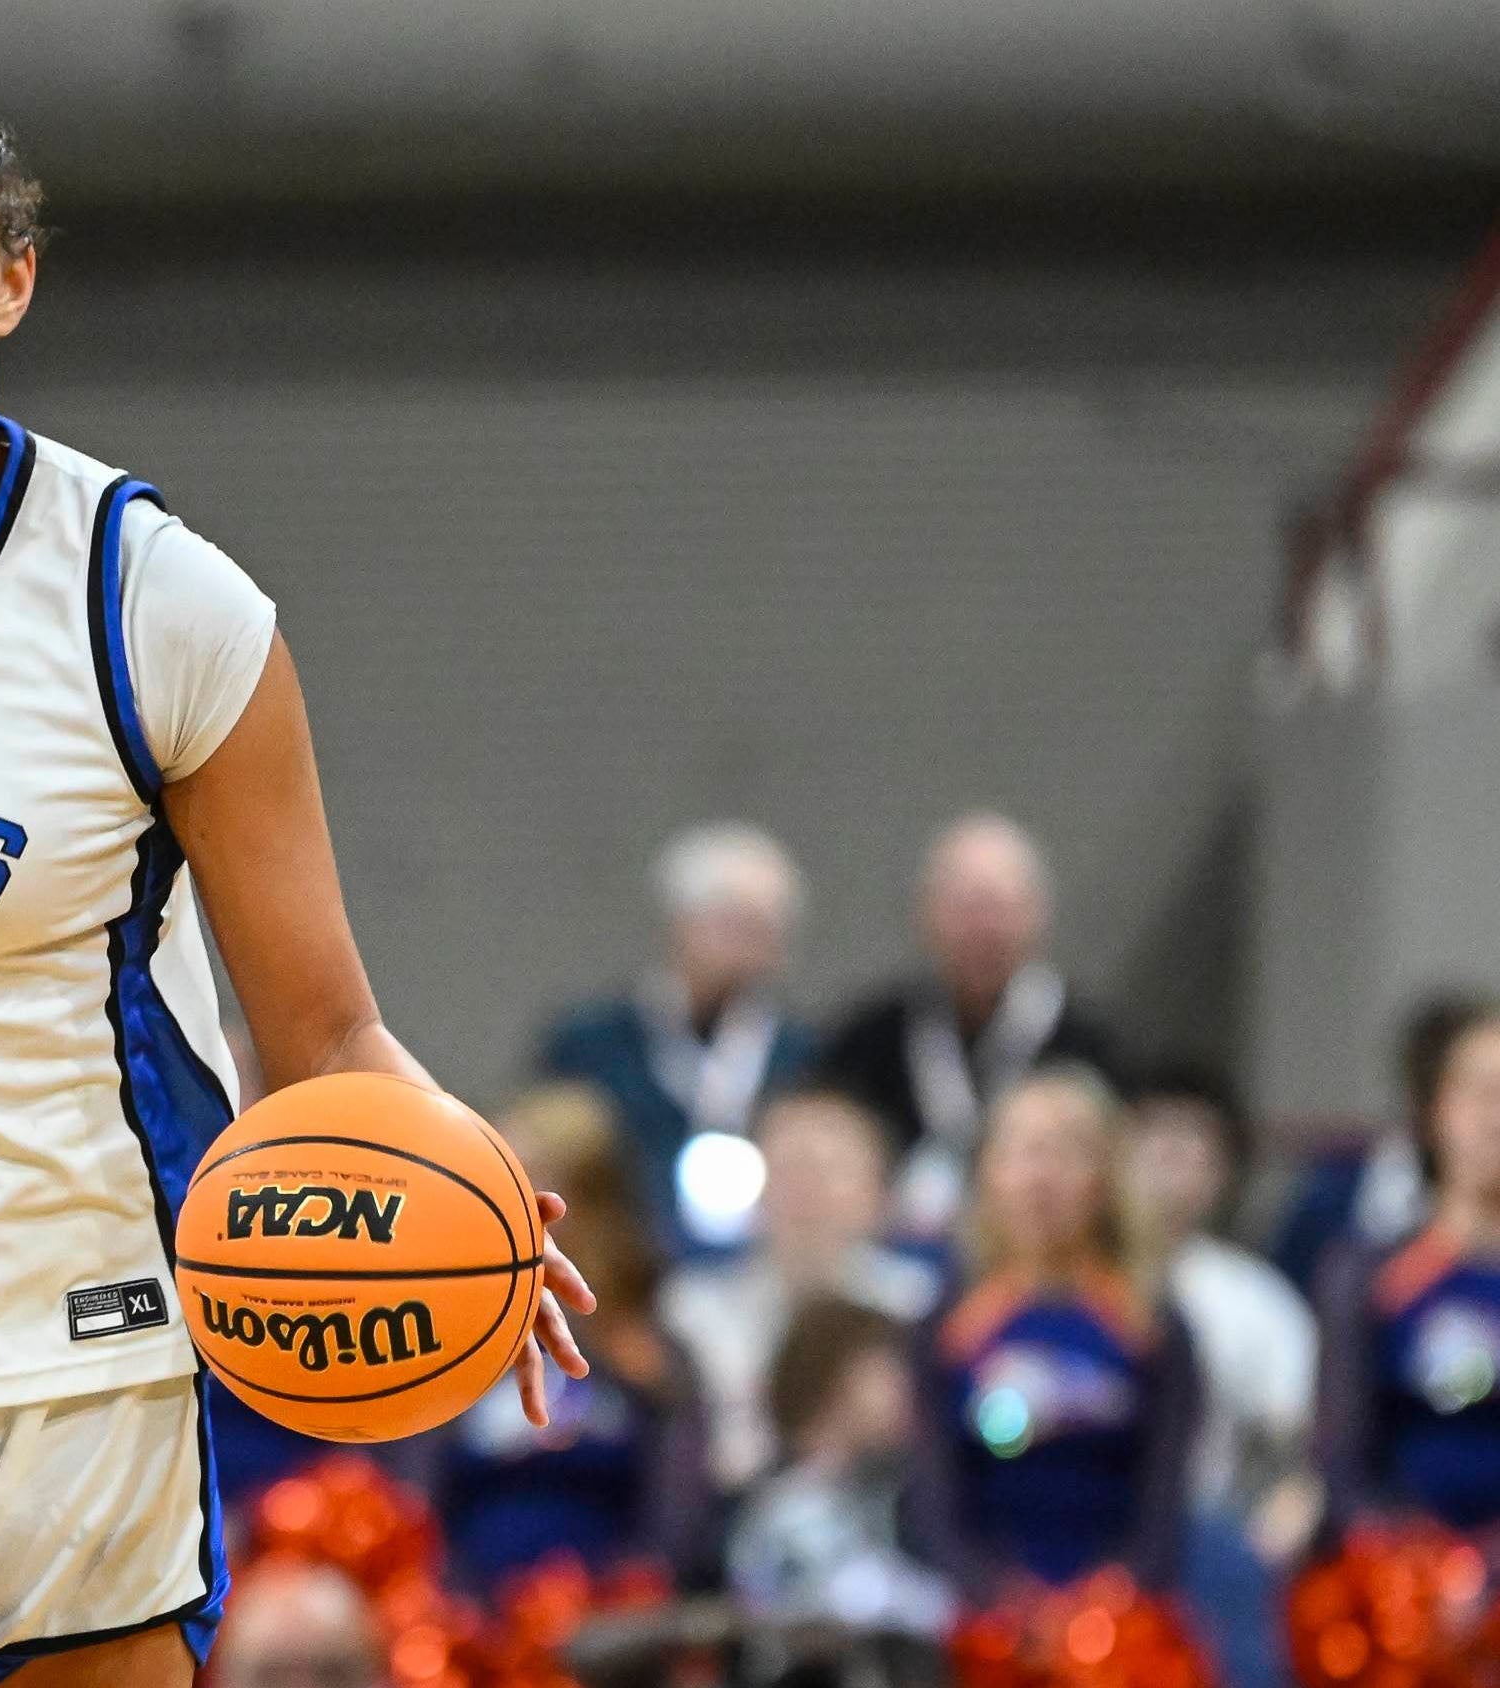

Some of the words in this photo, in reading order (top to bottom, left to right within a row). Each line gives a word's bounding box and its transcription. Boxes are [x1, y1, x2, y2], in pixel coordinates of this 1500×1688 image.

[233, 1171, 270, 1181] BALL
[274, 1170, 323, 1181] GAME
[329, 1171, 407, 1187] OFFICIAL
[227, 1186, 404, 1245] NCAA
[129, 1293, 158, 1315] XL
[199, 1292, 443, 1372] Wilson
